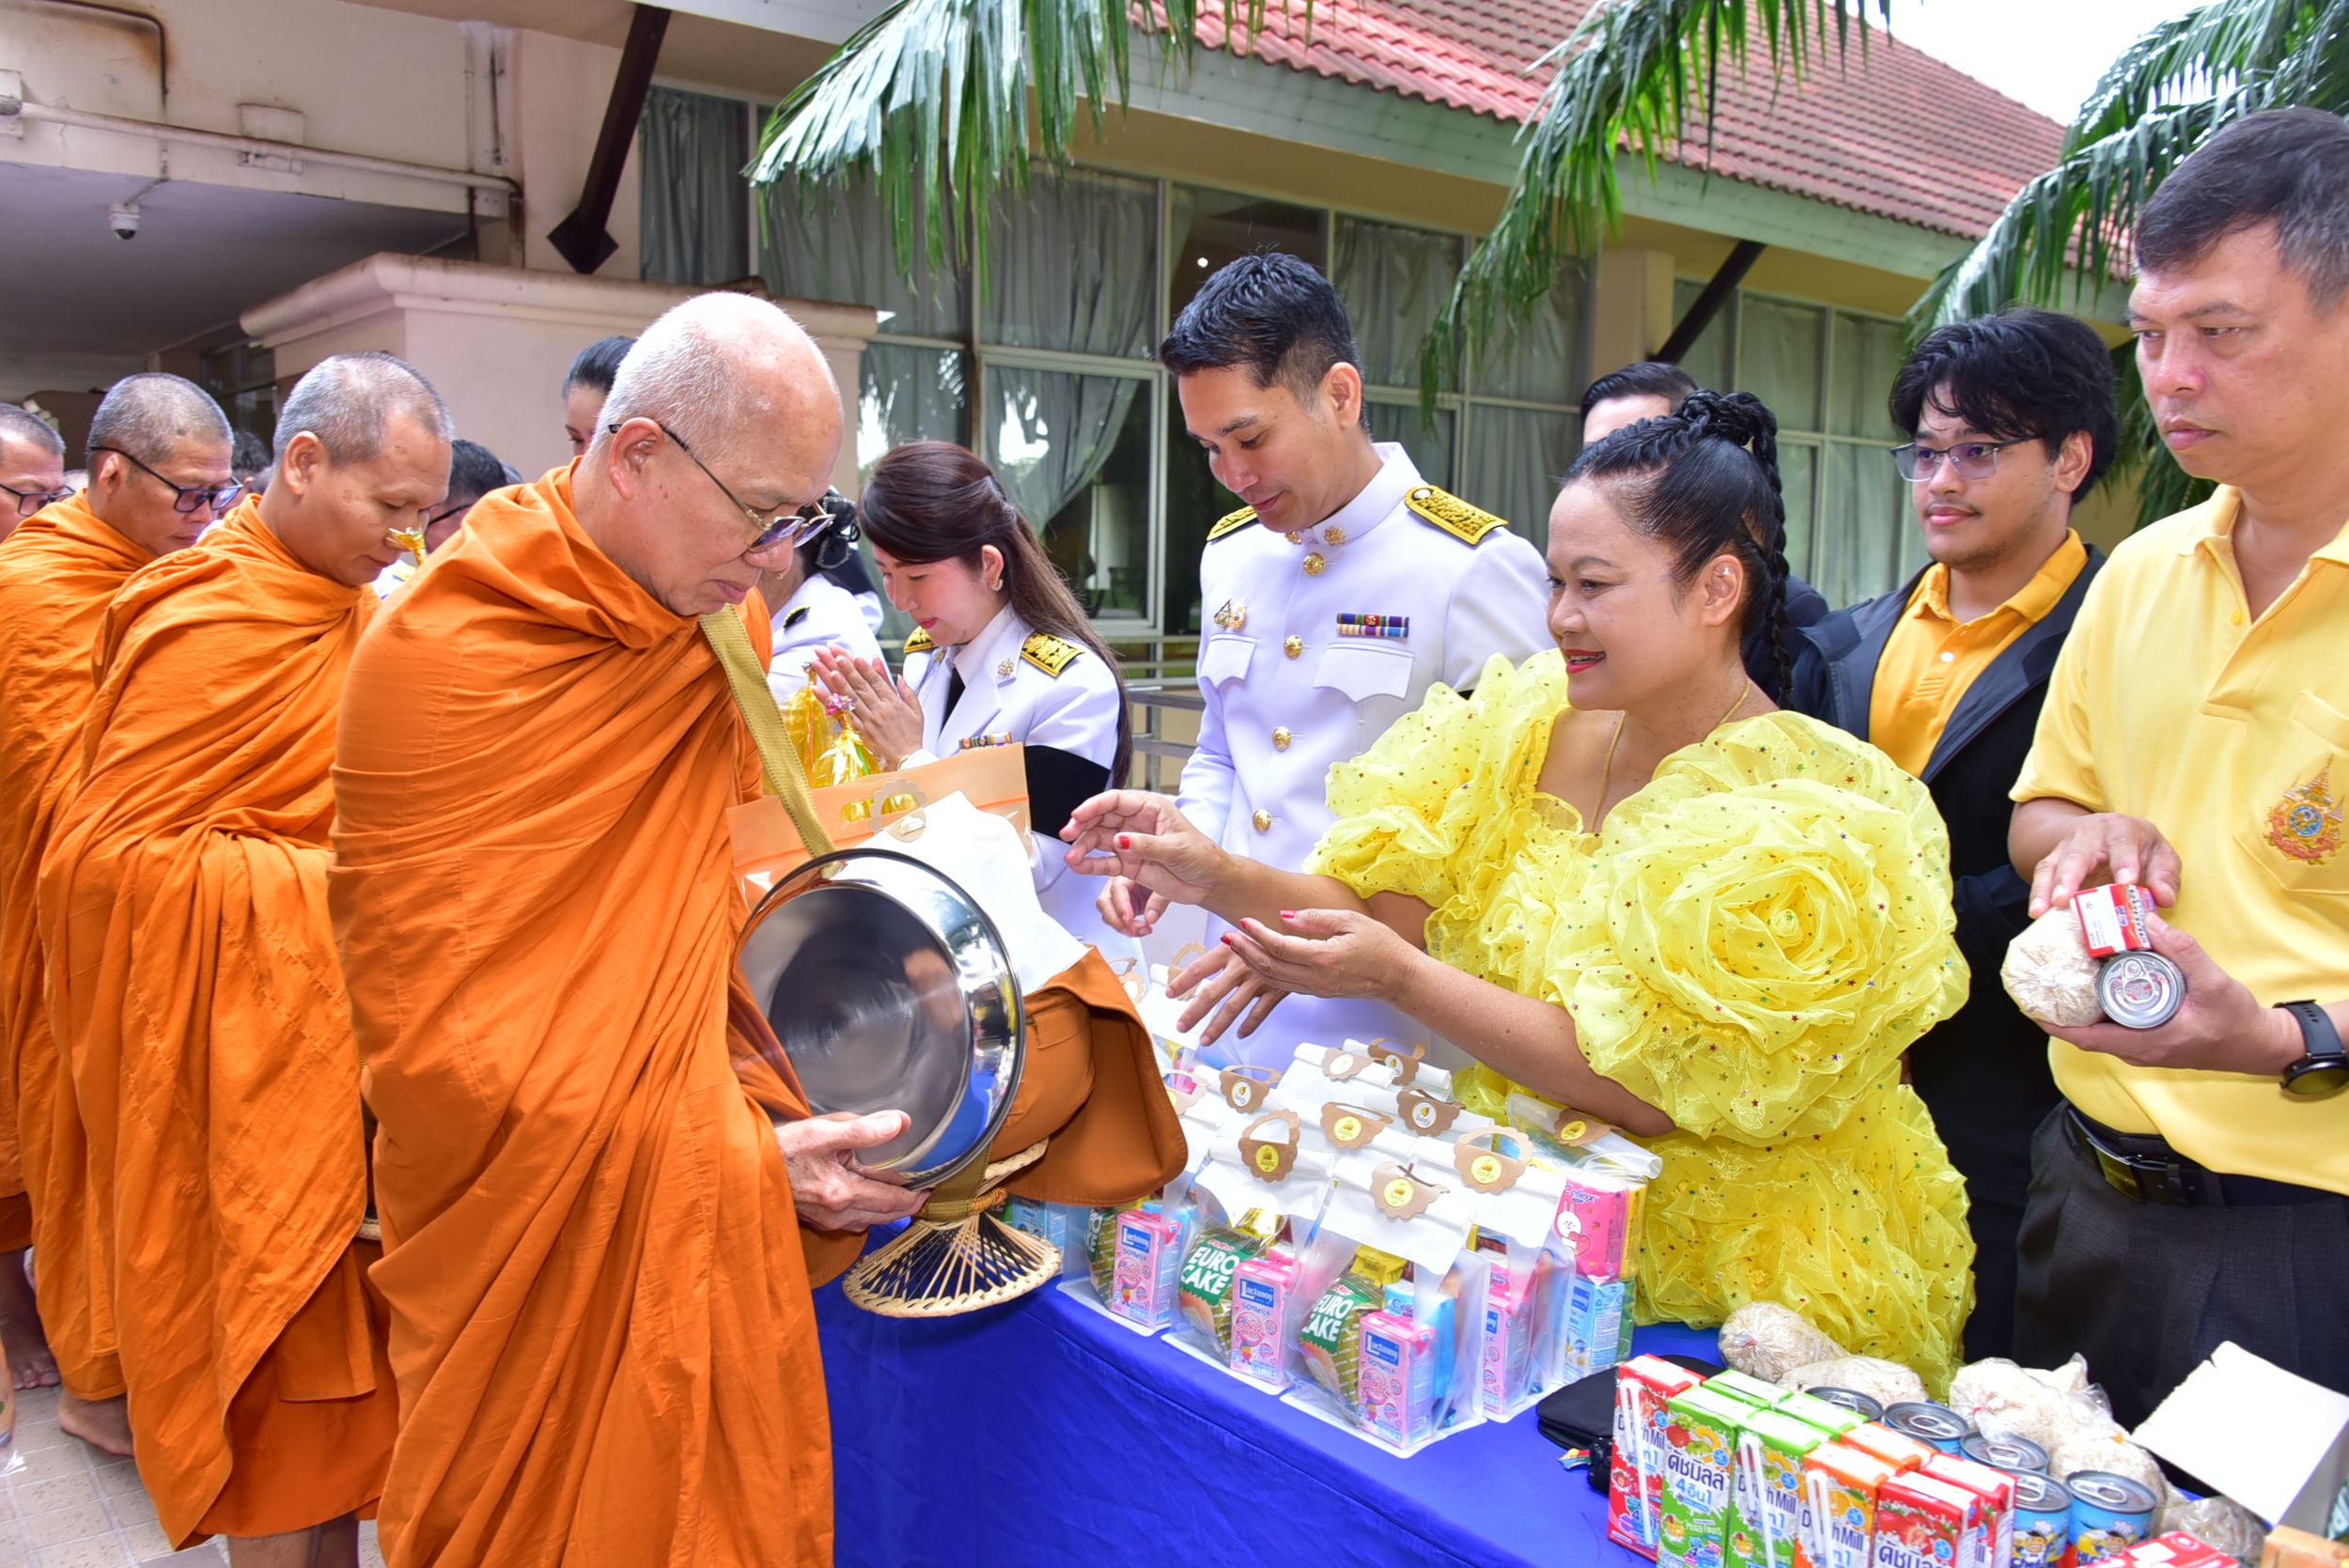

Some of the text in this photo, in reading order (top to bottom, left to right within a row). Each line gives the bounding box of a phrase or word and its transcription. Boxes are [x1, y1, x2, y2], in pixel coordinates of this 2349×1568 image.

[1188, 1247, 1240, 1275] EURO
[1180, 1265, 1230, 1295] CAKE
[1241, 1281, 1273, 1302] Lactasoy
[1367, 1334, 1399, 1358] Lactasoy
[1668, 1450, 1725, 1491] ดัชมิลล์
[1775, 1491, 1797, 1514] Mill
[1841, 1527, 1864, 1552] Mill
